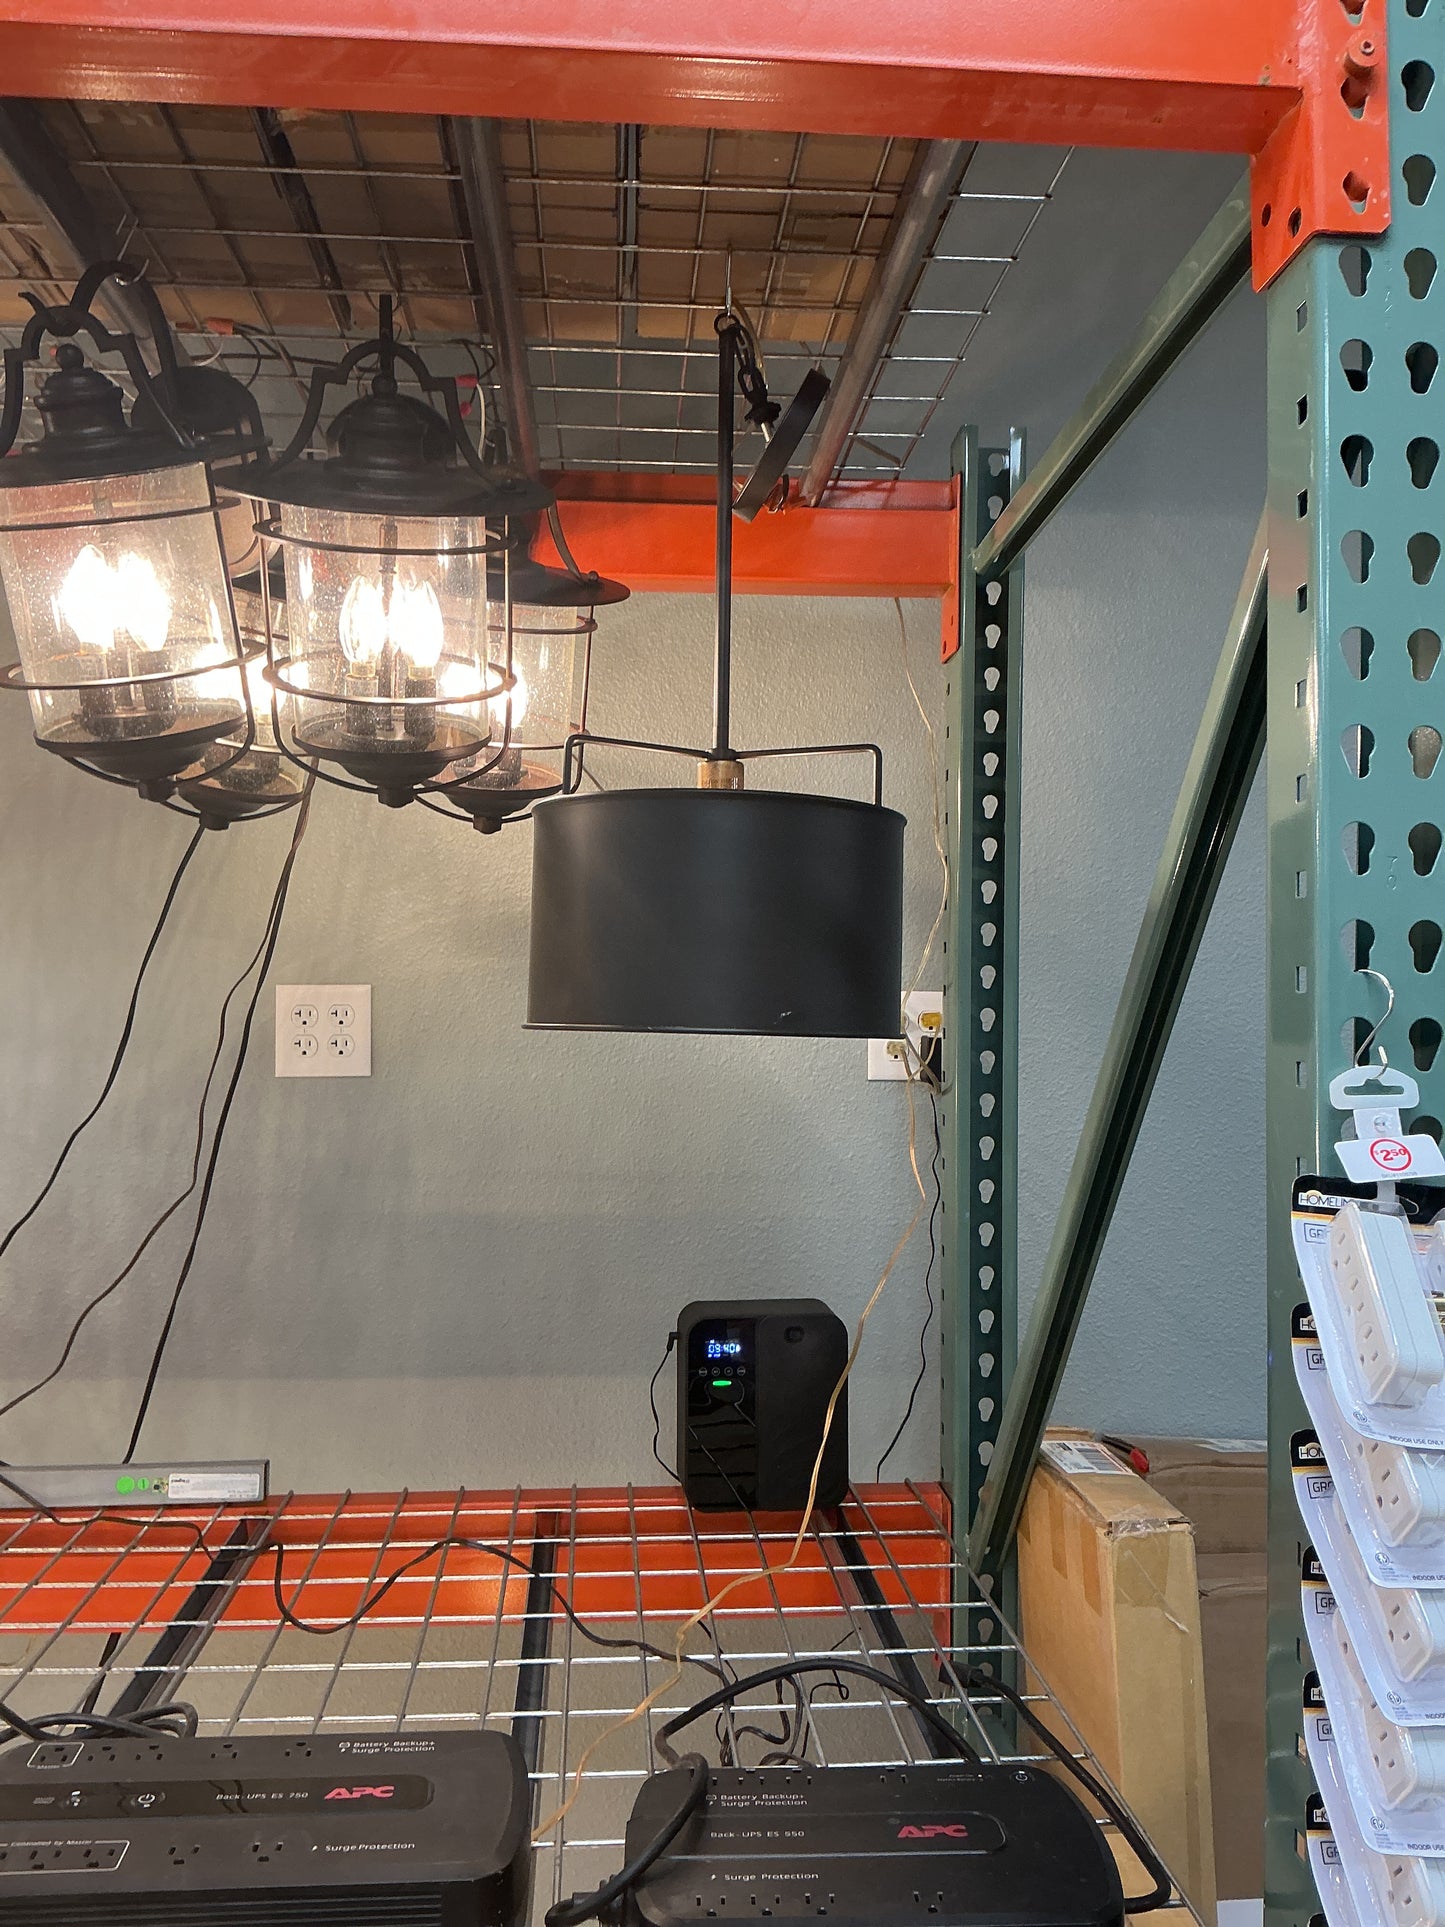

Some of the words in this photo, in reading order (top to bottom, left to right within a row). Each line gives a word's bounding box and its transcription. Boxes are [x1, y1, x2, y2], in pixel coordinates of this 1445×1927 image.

[323, 1785, 395, 1800] APC
[897, 1824, 969, 1838] APC
[724, 1874, 757, 1882] Surge
